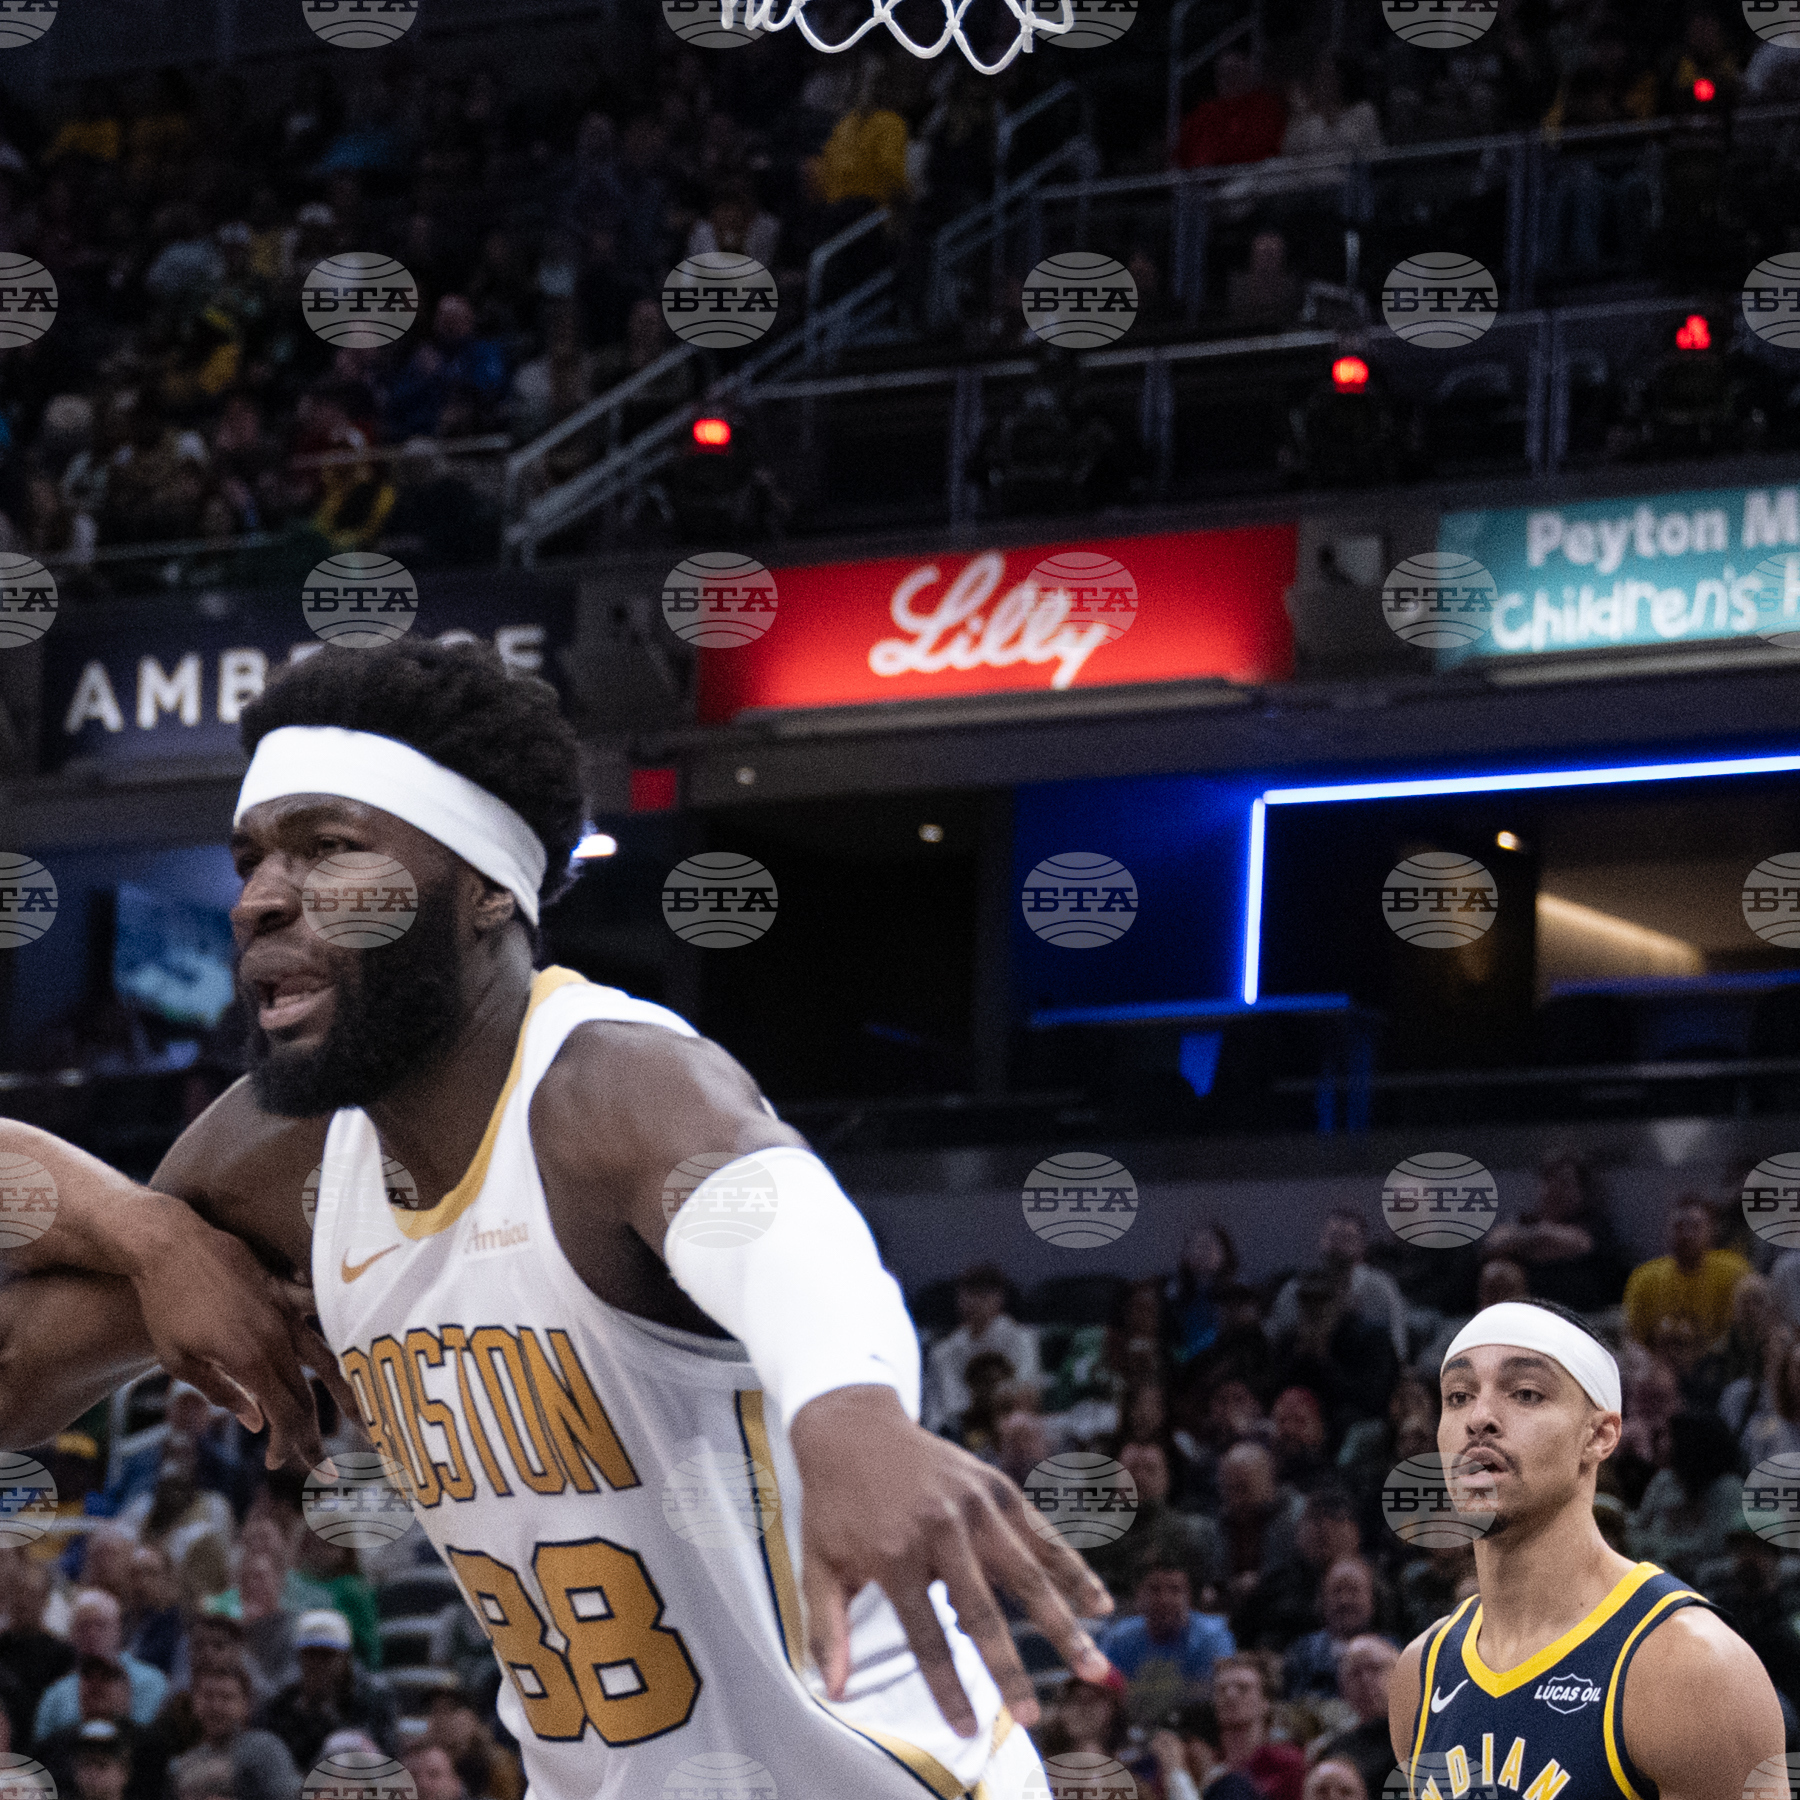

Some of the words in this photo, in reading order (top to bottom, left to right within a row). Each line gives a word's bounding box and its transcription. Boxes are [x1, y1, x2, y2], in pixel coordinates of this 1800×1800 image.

[1526, 504, 1729, 575] Peyton
[867, 551, 1109, 691] Lilly
[1491, 564, 1763, 652] Children's
[340, 1323, 643, 1509] BOSTON
[446, 1536, 703, 1748] 88
[1533, 1684, 1581, 1702] LUCAS
[1581, 1686, 1602, 1702] OIL
